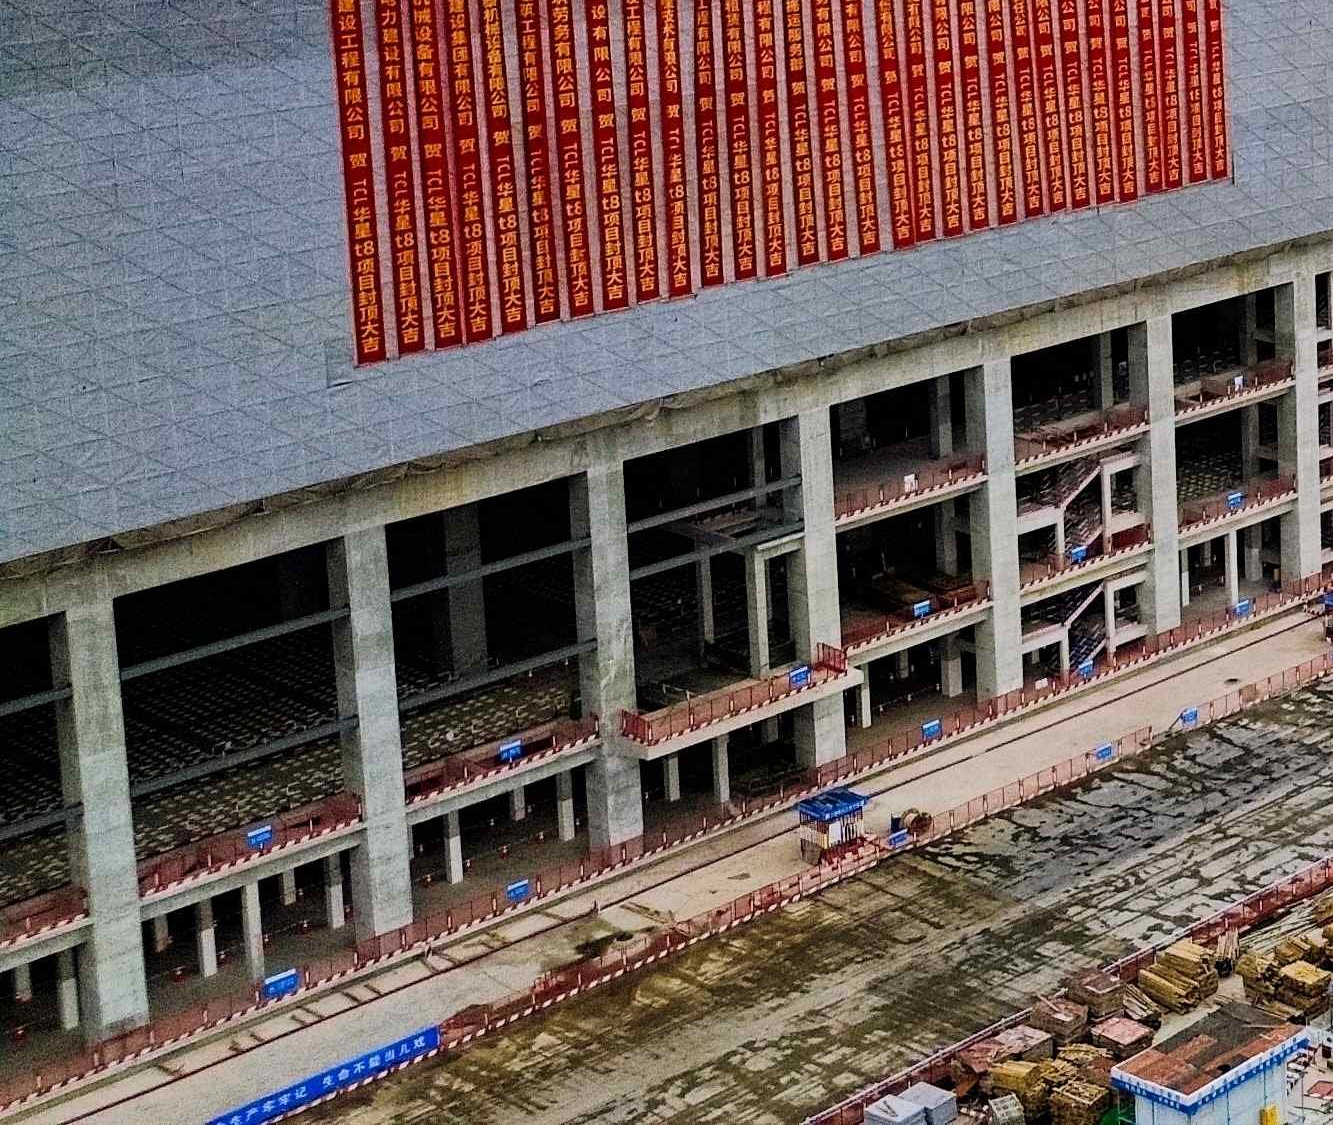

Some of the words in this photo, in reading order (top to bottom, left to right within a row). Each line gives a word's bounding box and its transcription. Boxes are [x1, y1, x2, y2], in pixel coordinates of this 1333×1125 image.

[1064, 40, 1077, 53] 贺
[1090, 37, 1102, 49] 贺
[1116, 36, 1127, 49] 贺
[992, 51, 1004, 64] 贺
[1017, 46, 1028, 59] 贺
[1040, 44, 1052, 57] 贺
[938, 60, 951, 74] 贺
[964, 55, 977, 68] 贺
[884, 70, 896, 83] 贺
[911, 64, 923, 77] 贺
[821, 77, 835, 91] 贺
[851, 74, 863, 87] 贺
[791, 81, 805, 95] 贺
[730, 91, 744, 106] 贺
[762, 89, 774, 103] 贺
[668, 104, 679, 117] 贺
[699, 97, 712, 110] 贺
[598, 113, 613, 128] 贺
[631, 107, 645, 121] 贺
[528, 125, 538, 139] 贺
[561, 118, 576, 133] 贺
[493, 130, 508, 145] 贺
[424, 143, 441, 157] 贺
[460, 138, 474, 152] 贺
[350, 152, 366, 167] 贺
[391, 145, 406, 160] 贺
[216, 1086, 308, 1125] 生产牢牢记
[322, 1035, 426, 1089] 生命不能当儿戏
